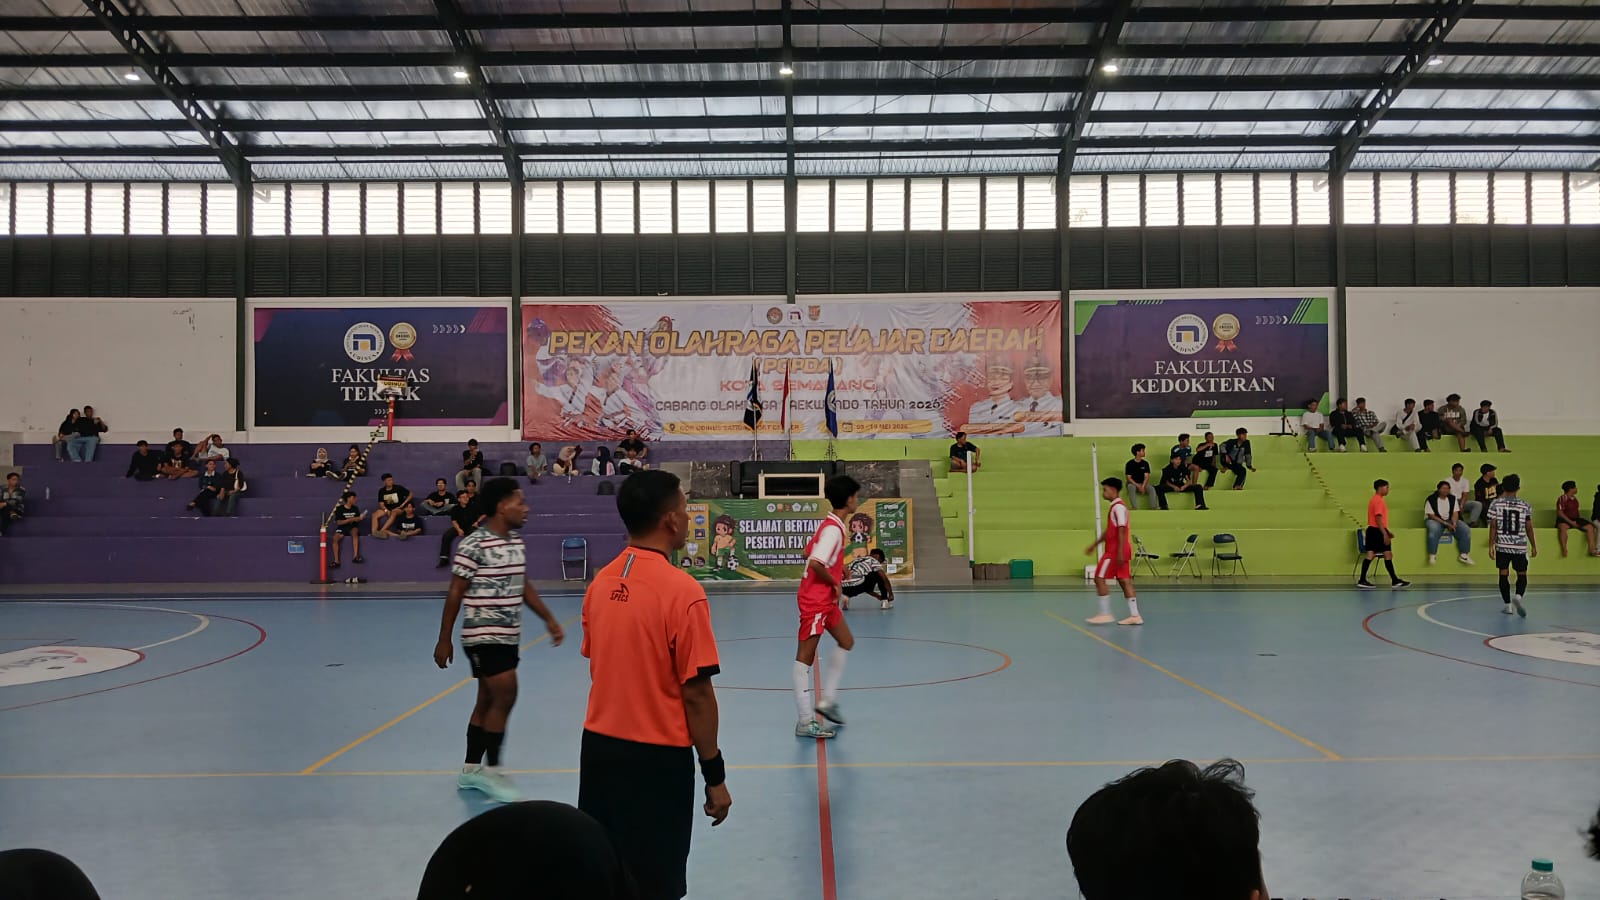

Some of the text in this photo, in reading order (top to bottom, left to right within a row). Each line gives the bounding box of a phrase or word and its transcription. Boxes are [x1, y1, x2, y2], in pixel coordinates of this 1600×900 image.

[550, 327, 1044, 356] PEKAN OLAHRAGA PELAJAR DAERAH
[1154, 360, 1253, 375] FAKULTAS
[720, 379, 877, 392] KOA SEMAANG
[1131, 377, 1275, 394] KEDOKTERAN
[340, 386, 421, 401] TEKK
[655, 399, 941, 411] CABANG OLAHGA AEKWNDO TAHUN 2026
[739, 519, 821, 533] SELAMAT BERTAN
[1502, 509, 1519, 535] 10
[745, 536, 785, 549] PESERTA
[788, 535, 804, 549] FIX
[610, 592, 628, 602] SPECS
